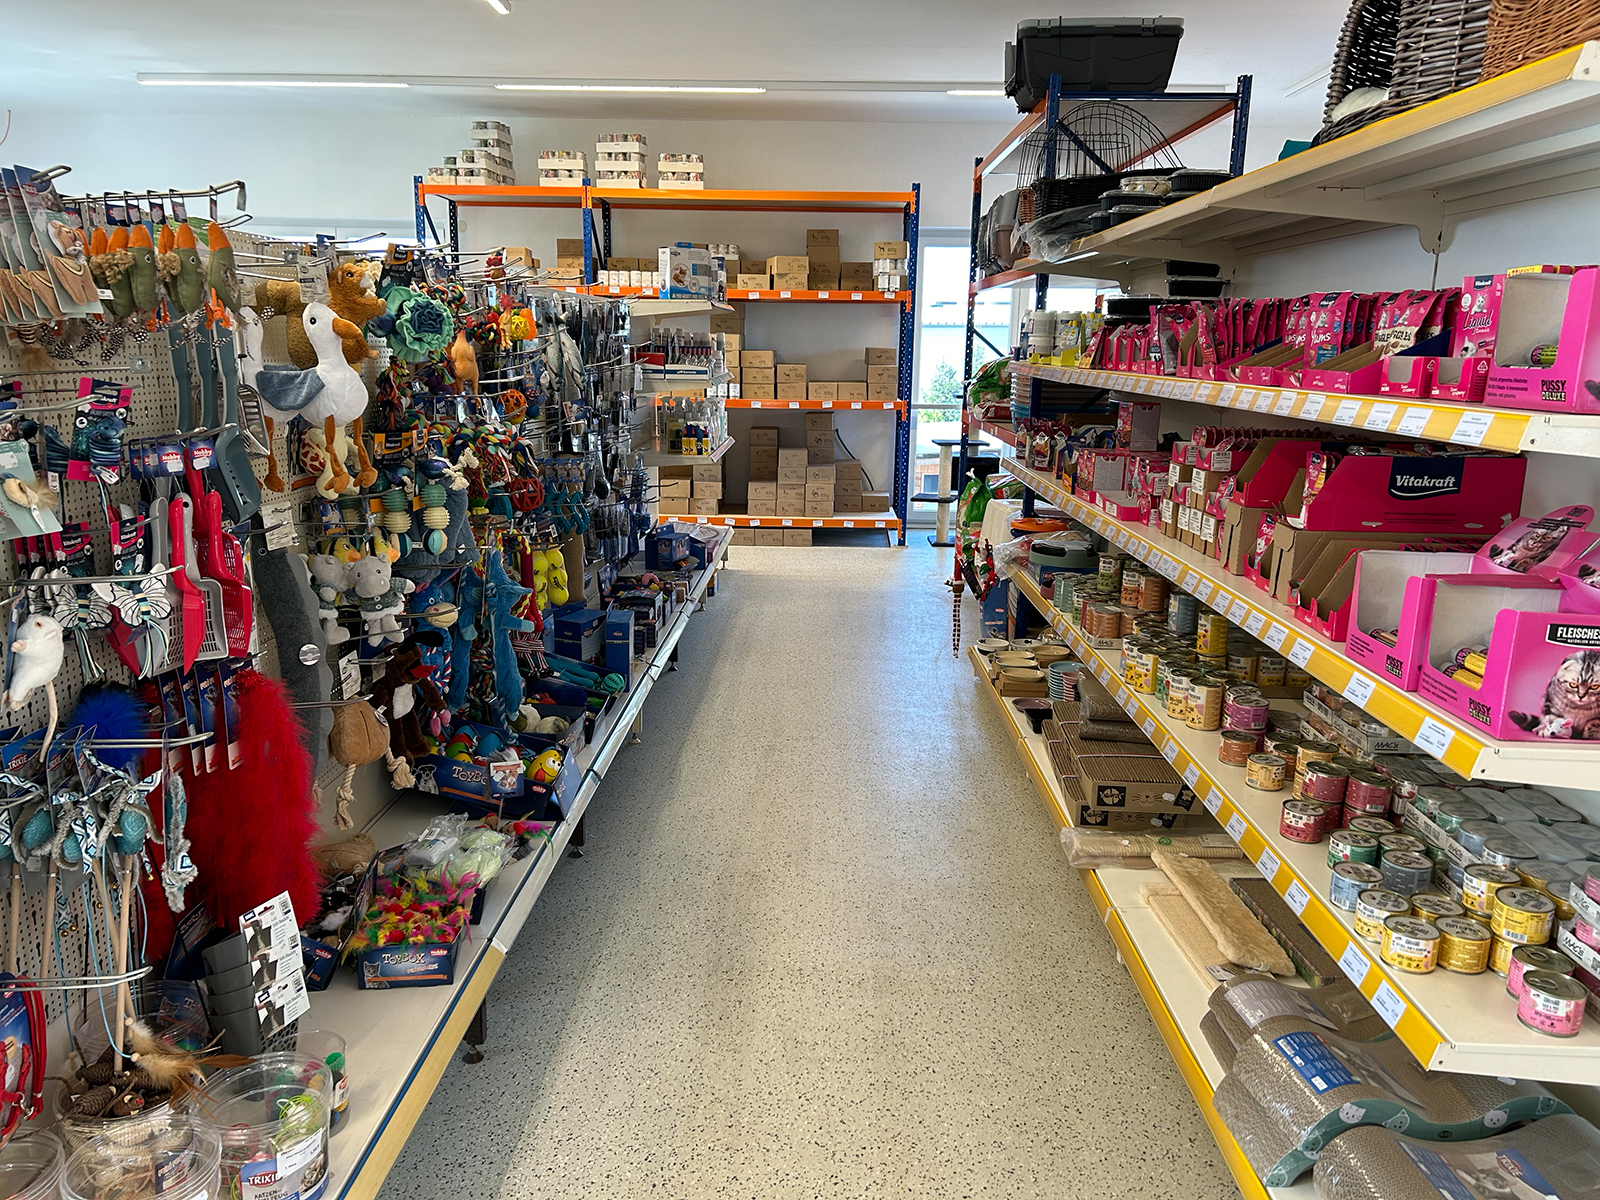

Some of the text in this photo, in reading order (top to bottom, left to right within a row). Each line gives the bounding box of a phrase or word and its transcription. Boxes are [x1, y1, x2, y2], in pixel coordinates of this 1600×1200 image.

[1463, 310, 1494, 335] Liquid
[1541, 380, 1566, 390] PUSSY
[1541, 391, 1566, 402] DELUXE
[1396, 475, 1456, 487] Vitakraft
[1557, 627, 1600, 639] FLEISCHE
[1386, 654, 1403, 668] PUSSY
[1469, 698, 1491, 716] PUSSY
[8, 754, 28, 769] TRIXIE
[254, 1189, 282, 1199] KATZEN-
